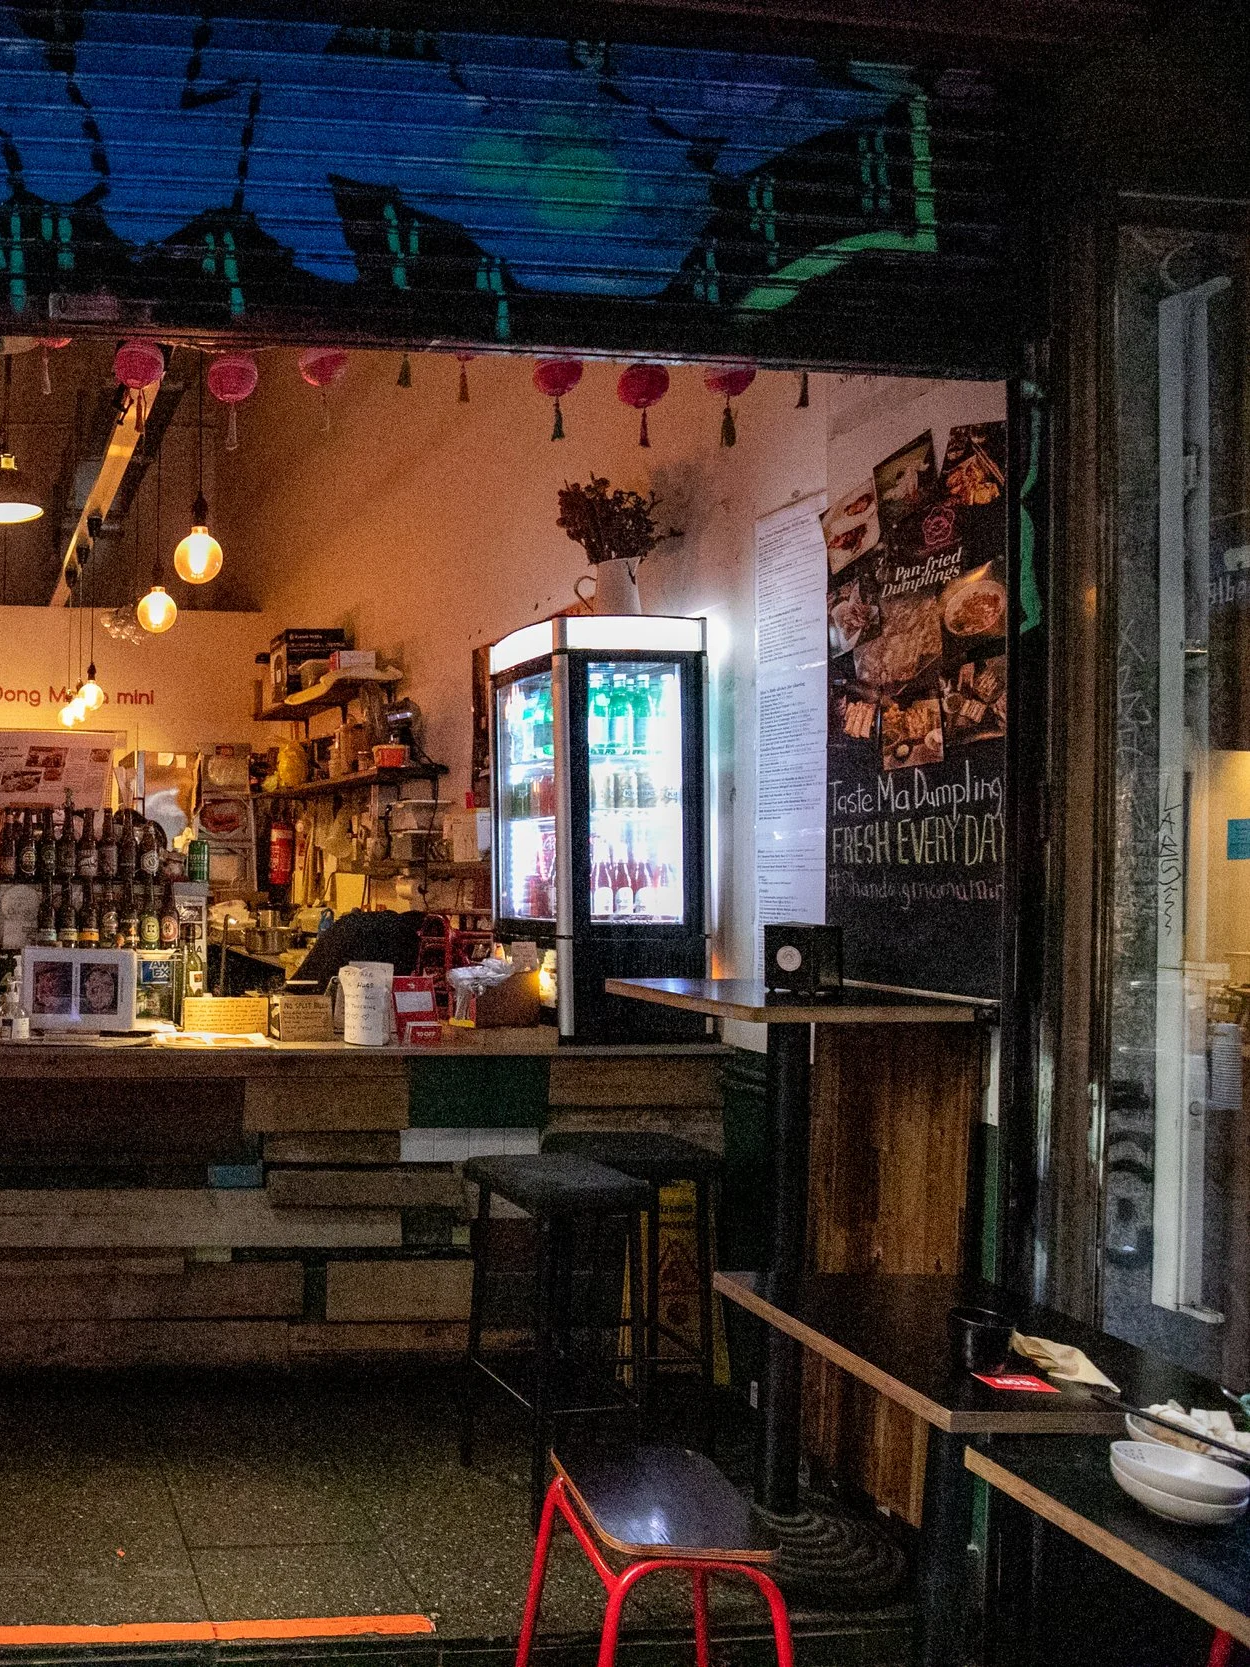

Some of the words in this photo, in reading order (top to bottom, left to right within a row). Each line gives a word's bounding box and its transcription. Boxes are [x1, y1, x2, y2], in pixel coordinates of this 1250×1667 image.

[895, 547, 963, 581] Pan-fried
[881, 565, 961, 598] Dumplings
[117, 689, 155, 706] mini
[828, 780, 875, 816] Taste
[877, 772, 911, 813] Ma
[914, 759, 1002, 822] Dumpling
[832, 820, 891, 865] FRESH
[897, 813, 961, 865] EVERY
[152, 969, 171, 977] EX
